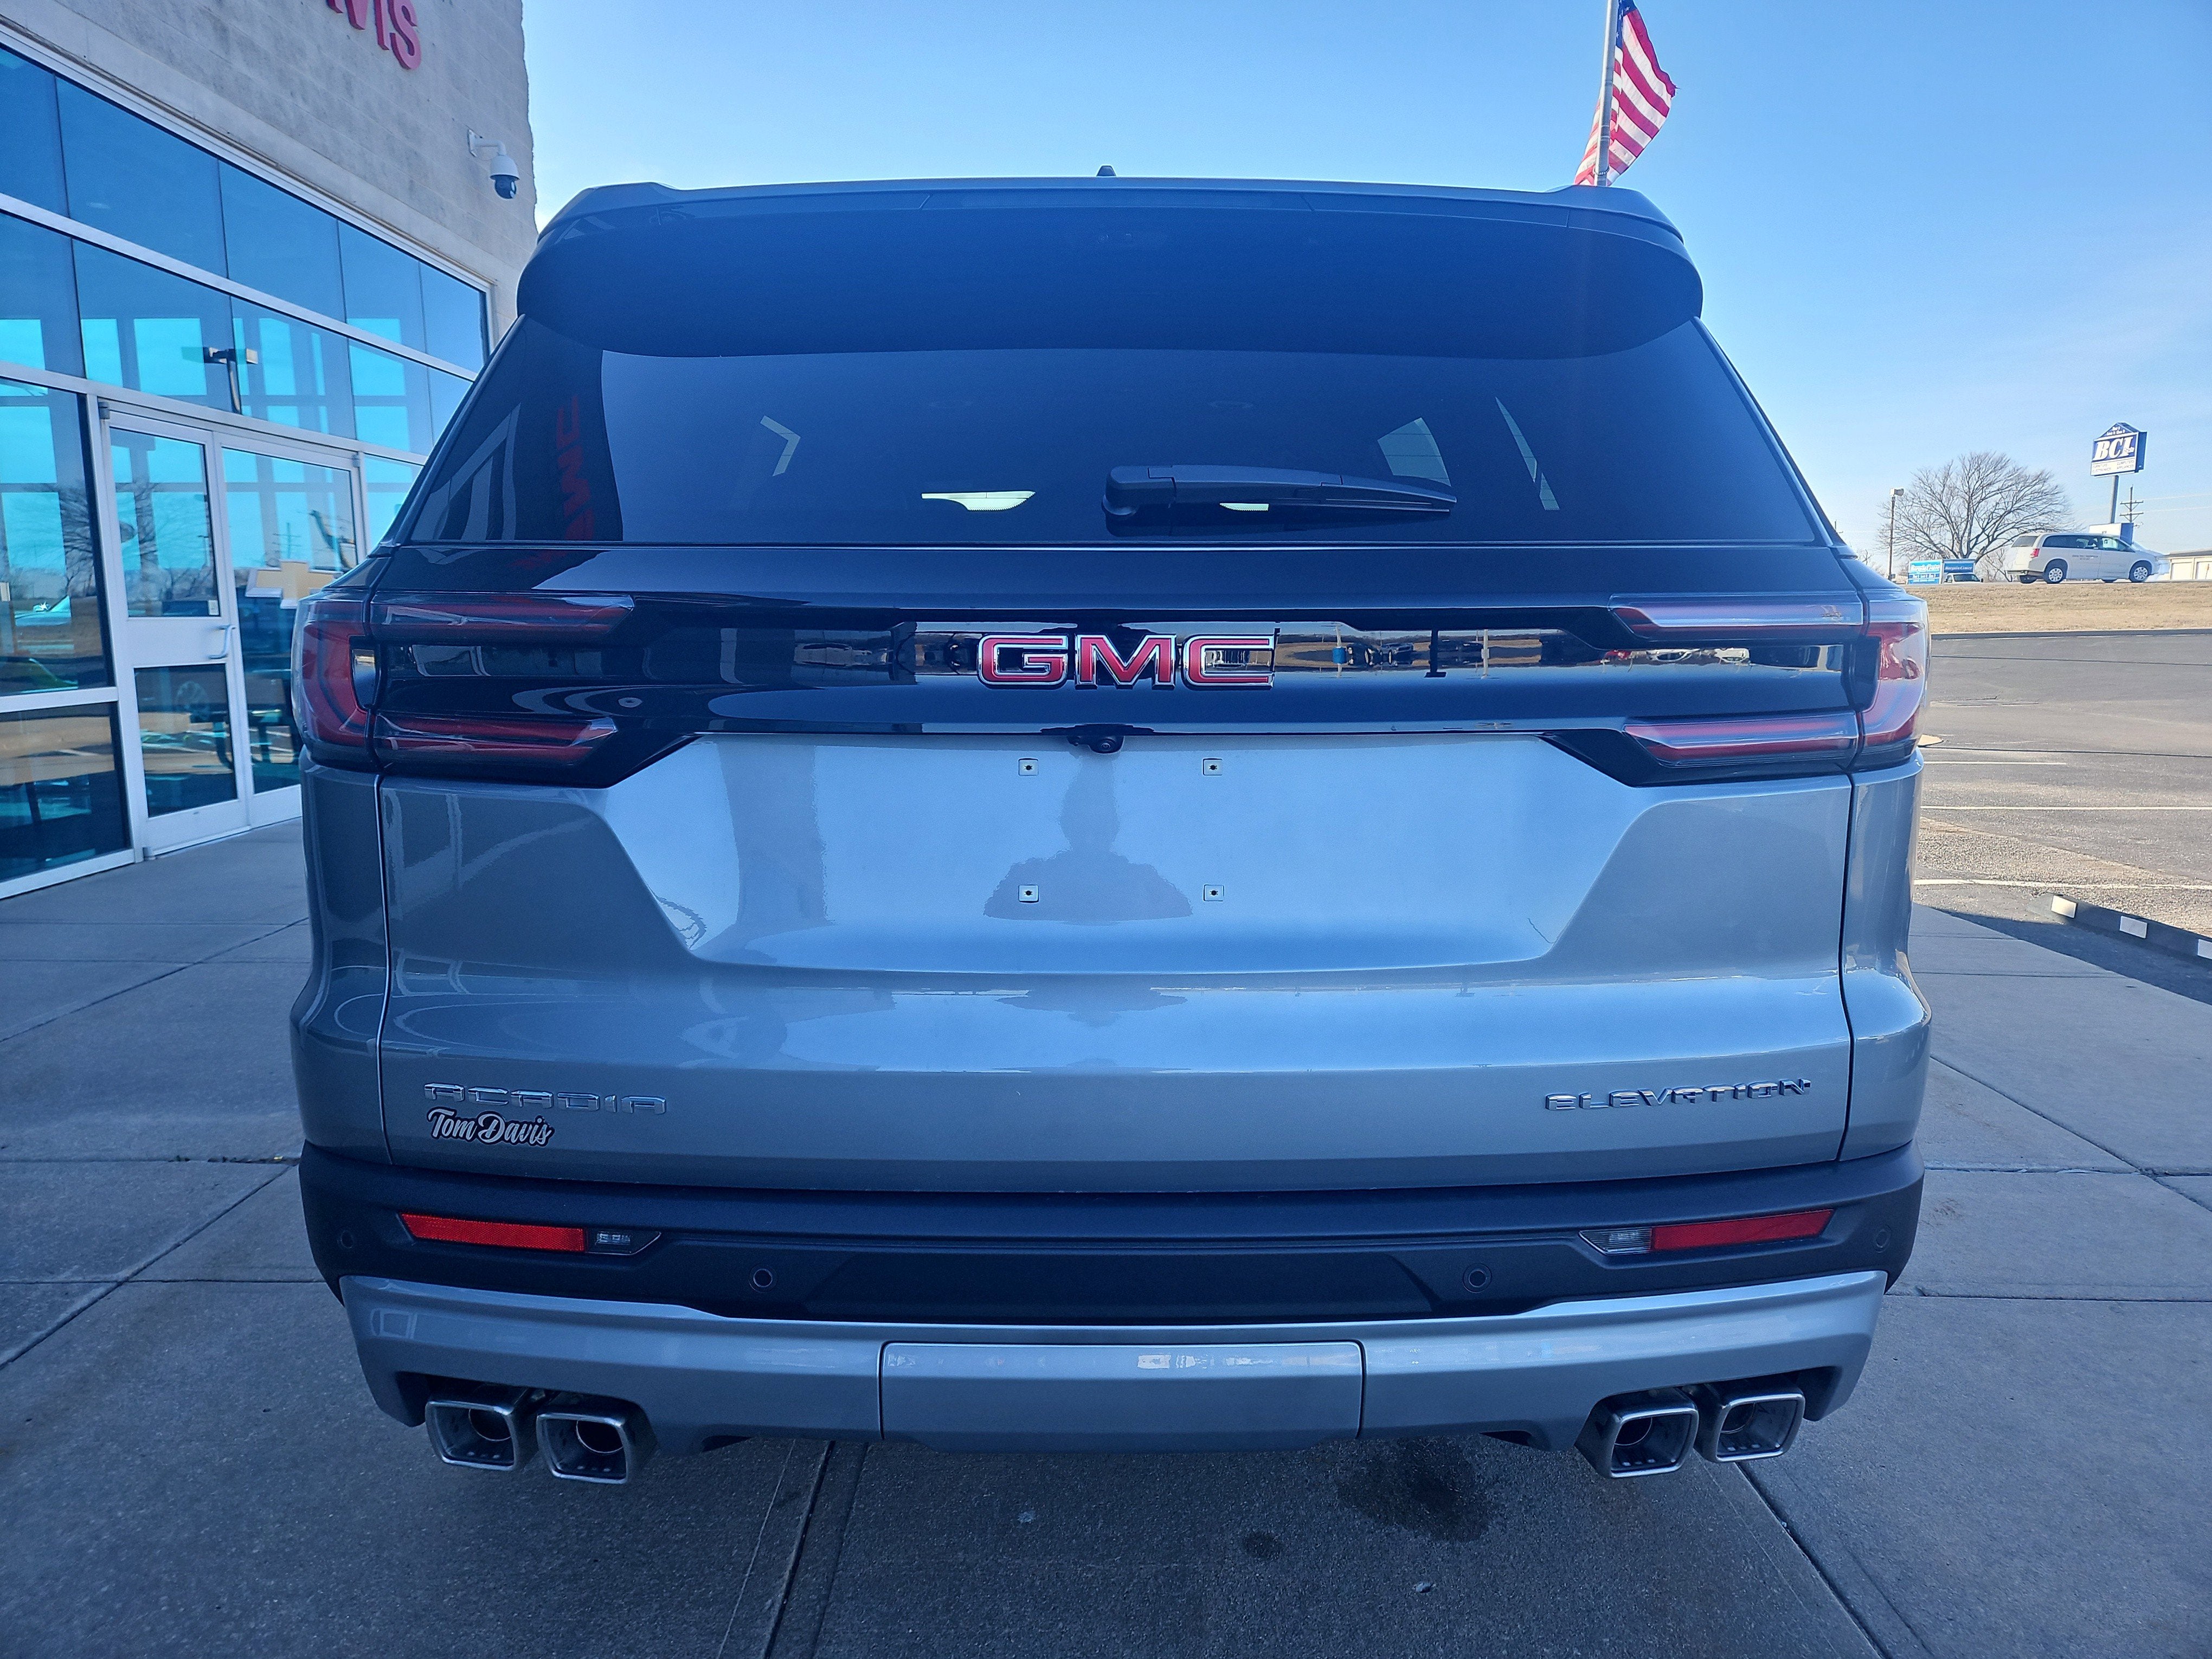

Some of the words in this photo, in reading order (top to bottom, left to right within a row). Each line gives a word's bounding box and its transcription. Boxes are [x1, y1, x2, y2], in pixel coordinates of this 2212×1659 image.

[978, 634, 1275, 689] GMC
[425, 1083, 667, 1115] ACADIA
[1545, 1078, 1811, 1111] ELEVATION
[427, 1108, 477, 1140] Tom
[478, 1113, 554, 1146] Davis
